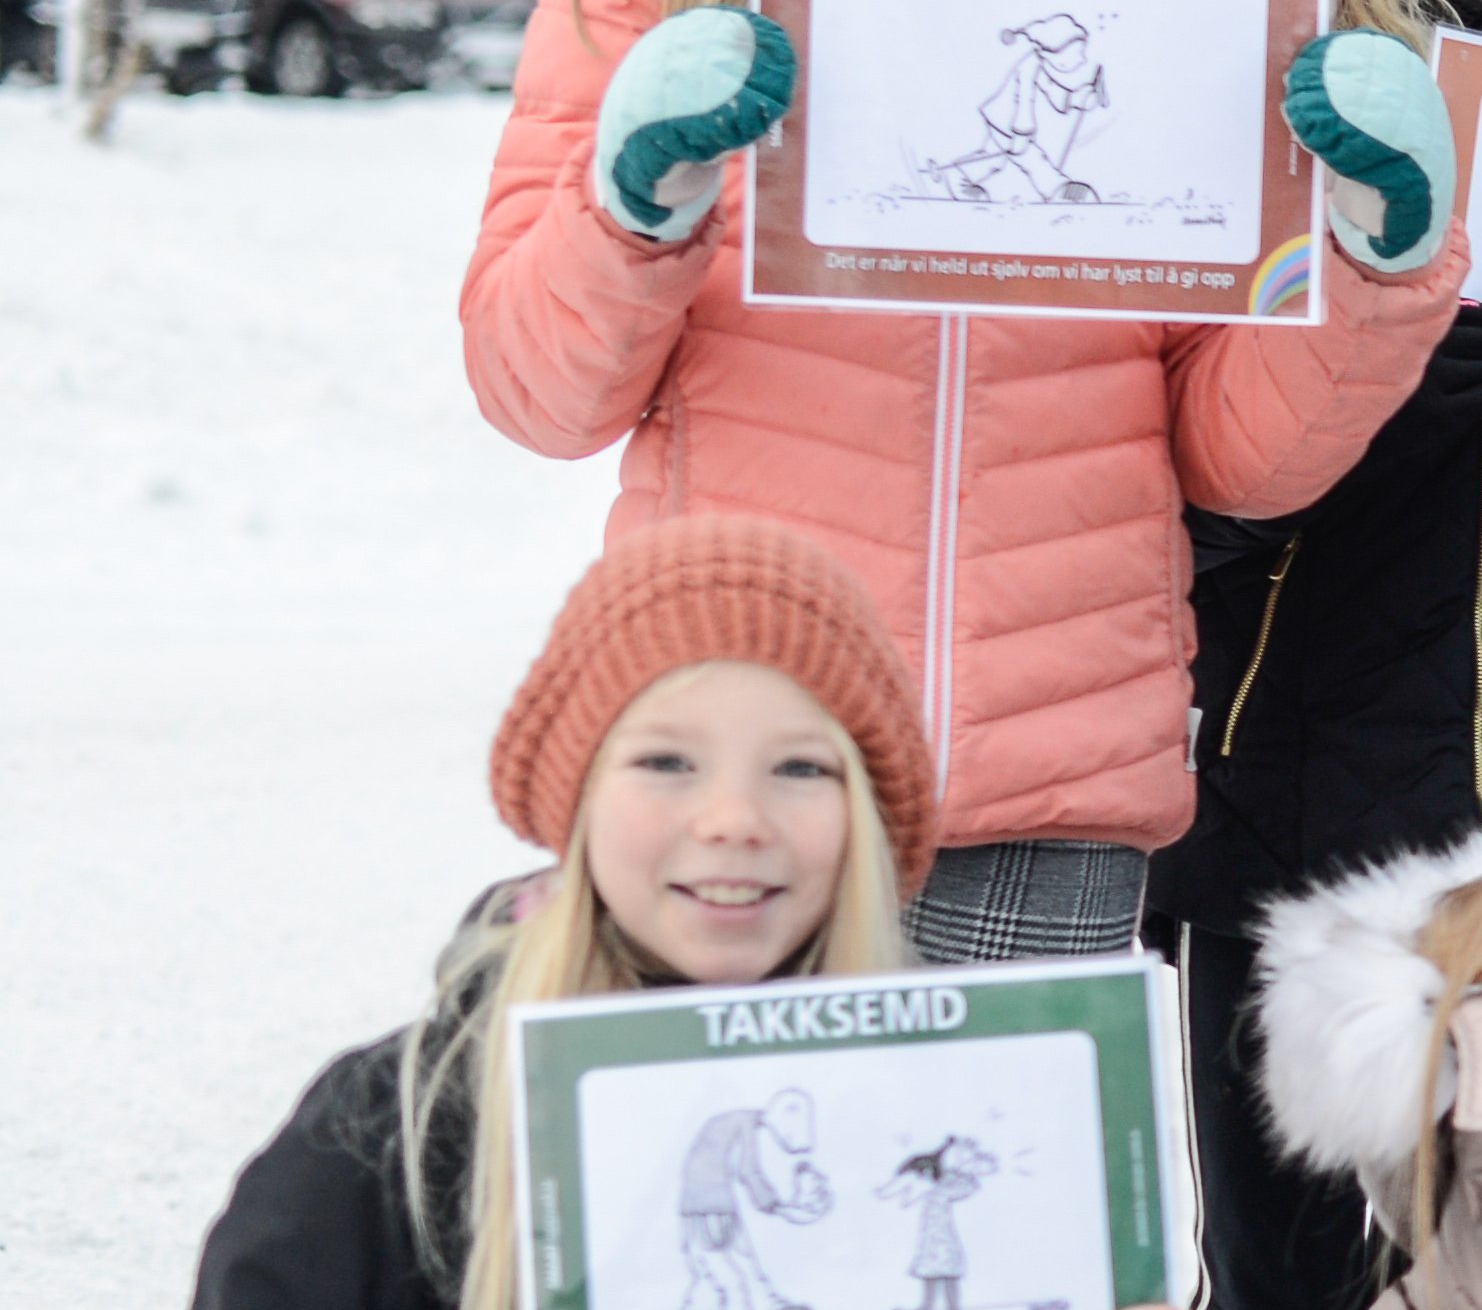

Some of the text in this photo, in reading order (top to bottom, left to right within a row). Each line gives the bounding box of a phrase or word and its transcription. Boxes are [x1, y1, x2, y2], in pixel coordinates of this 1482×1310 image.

[825, 252, 1235, 289] Det er når vi held ut sjølv om vi har lyst til å gi opp
[698, 988, 967, 1047] TAKKSEMD
